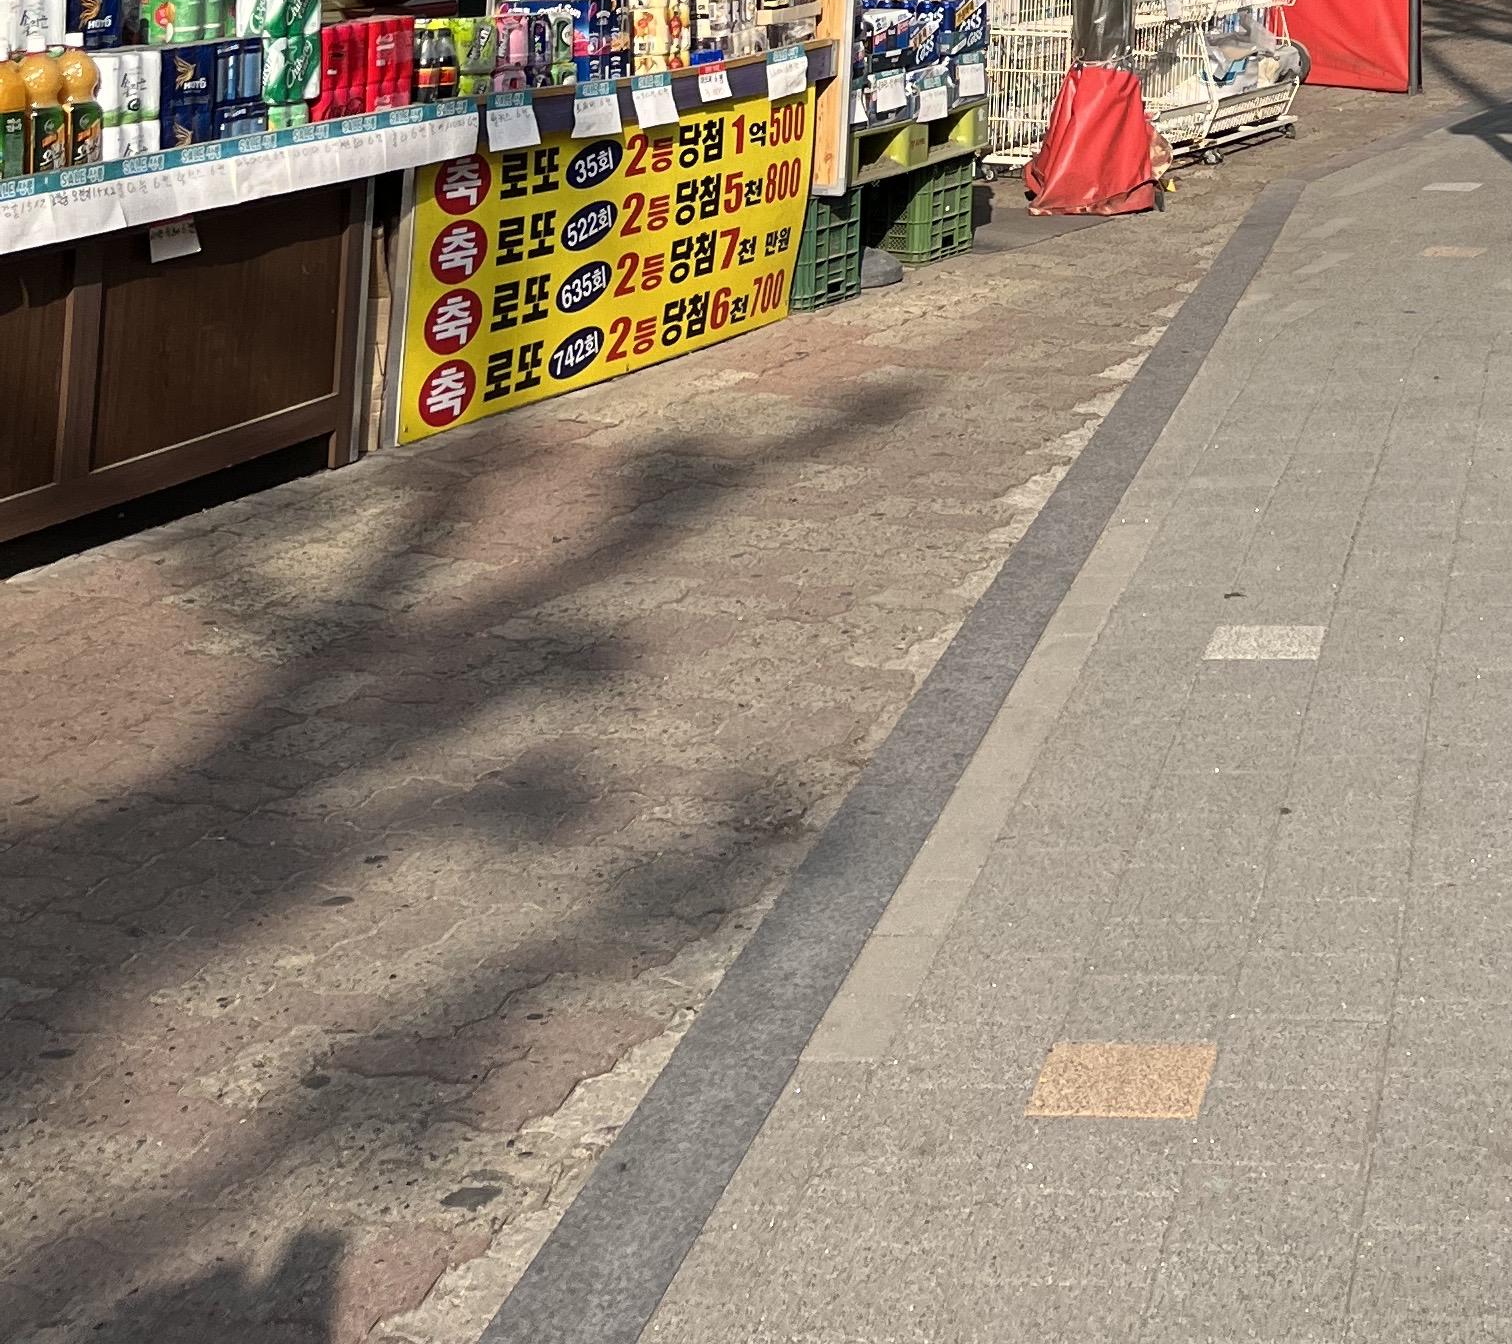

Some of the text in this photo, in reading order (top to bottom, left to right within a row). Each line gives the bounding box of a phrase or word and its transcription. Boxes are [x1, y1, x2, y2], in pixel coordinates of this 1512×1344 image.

[442, 154, 484, 207] 축
[500, 147, 560, 200] 로또
[573, 144, 617, 181] 35회
[624, 133, 674, 177] 2등
[679, 116, 724, 169] 당첨
[438, 223, 483, 277] 축
[496, 209, 556, 266] 로또
[566, 205, 614, 248] 522회
[620, 192, 671, 237] 2등
[676, 175, 721, 226] 당첨
[431, 292, 478, 348] 축
[490, 275, 550, 332] 로또
[561, 269, 608, 309] 635회
[613, 252, 665, 298] 2등
[669, 232, 717, 284] 당첨
[764, 227, 792, 258] 만원
[425, 365, 473, 417] 축
[483, 340, 544, 402] 로또
[553, 335, 600, 377] 742회
[605, 317, 657, 363] 2등
[661, 291, 711, 346] 당첨
